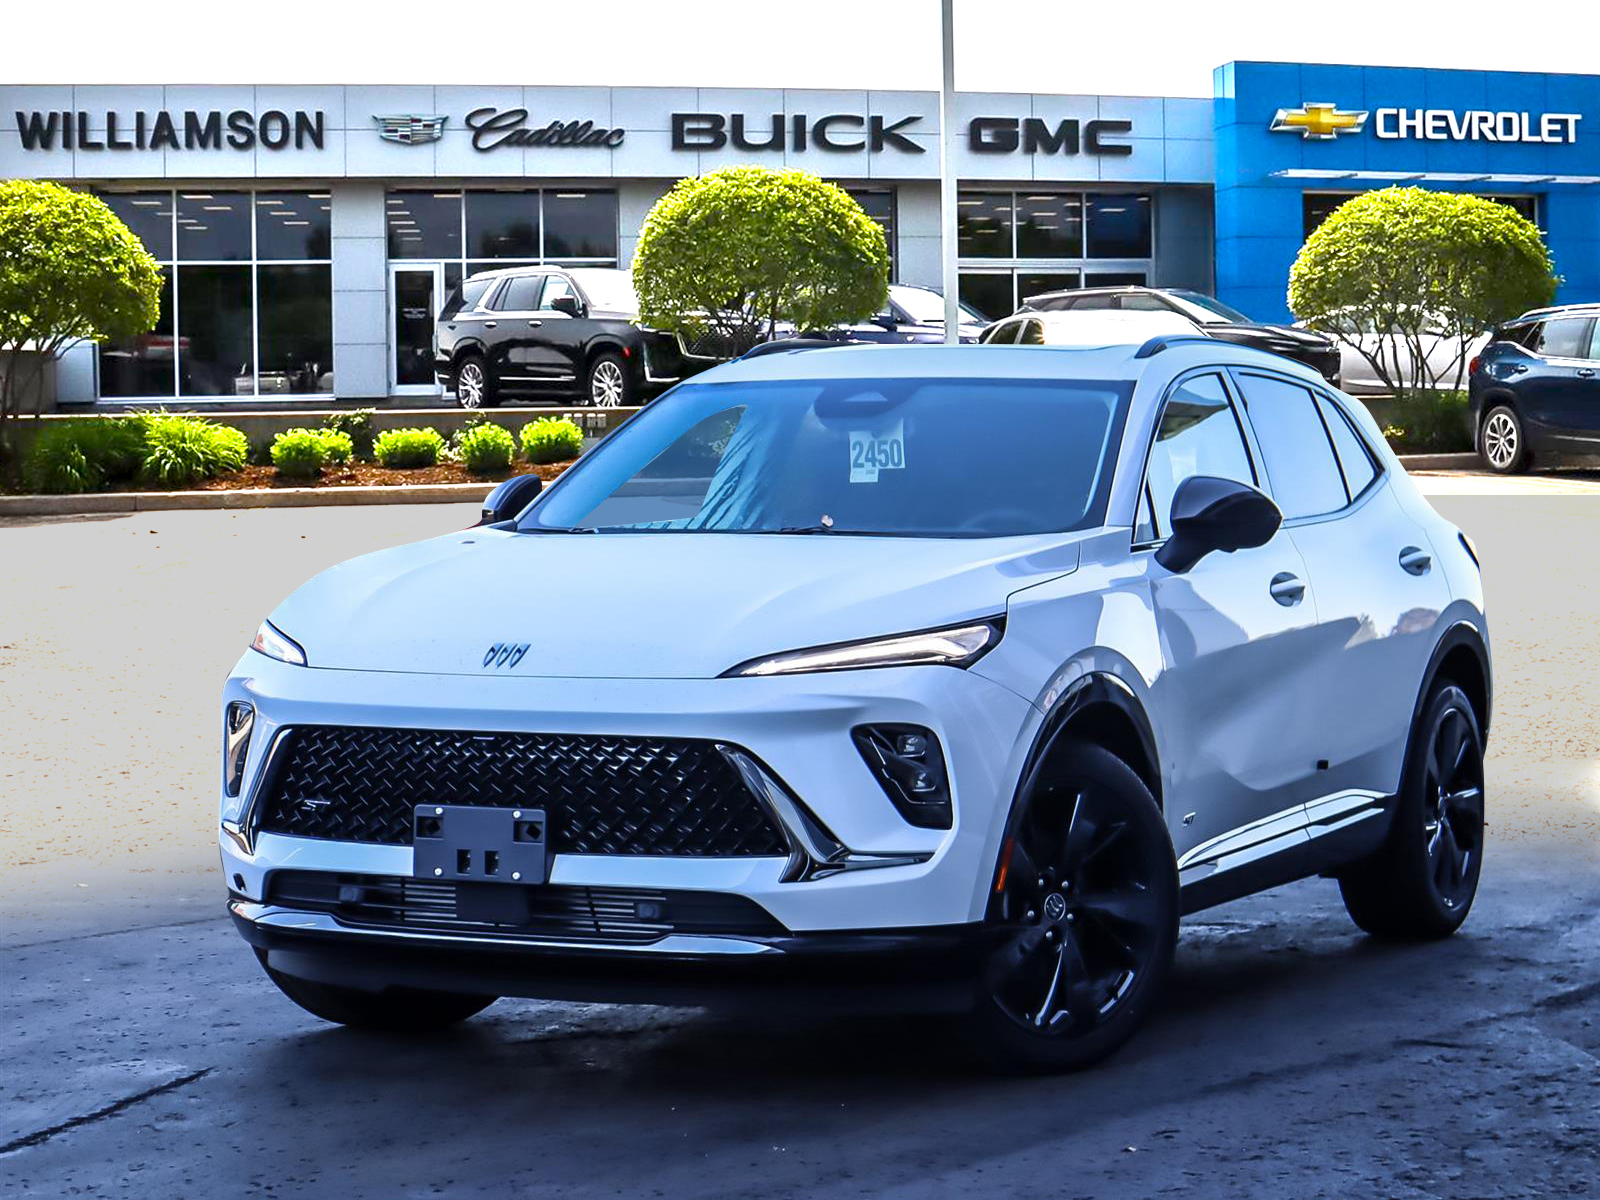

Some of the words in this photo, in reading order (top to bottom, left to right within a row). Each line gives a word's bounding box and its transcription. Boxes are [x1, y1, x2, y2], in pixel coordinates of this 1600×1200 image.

[15, 110, 324, 150] WILLIAMSON
[465, 107, 625, 152] Cadillac
[671, 113, 926, 153] BUICK
[970, 117, 1132, 155] GMC
[1376, 108, 1582, 143] CHEVROLET
[852, 439, 903, 468] 2450
